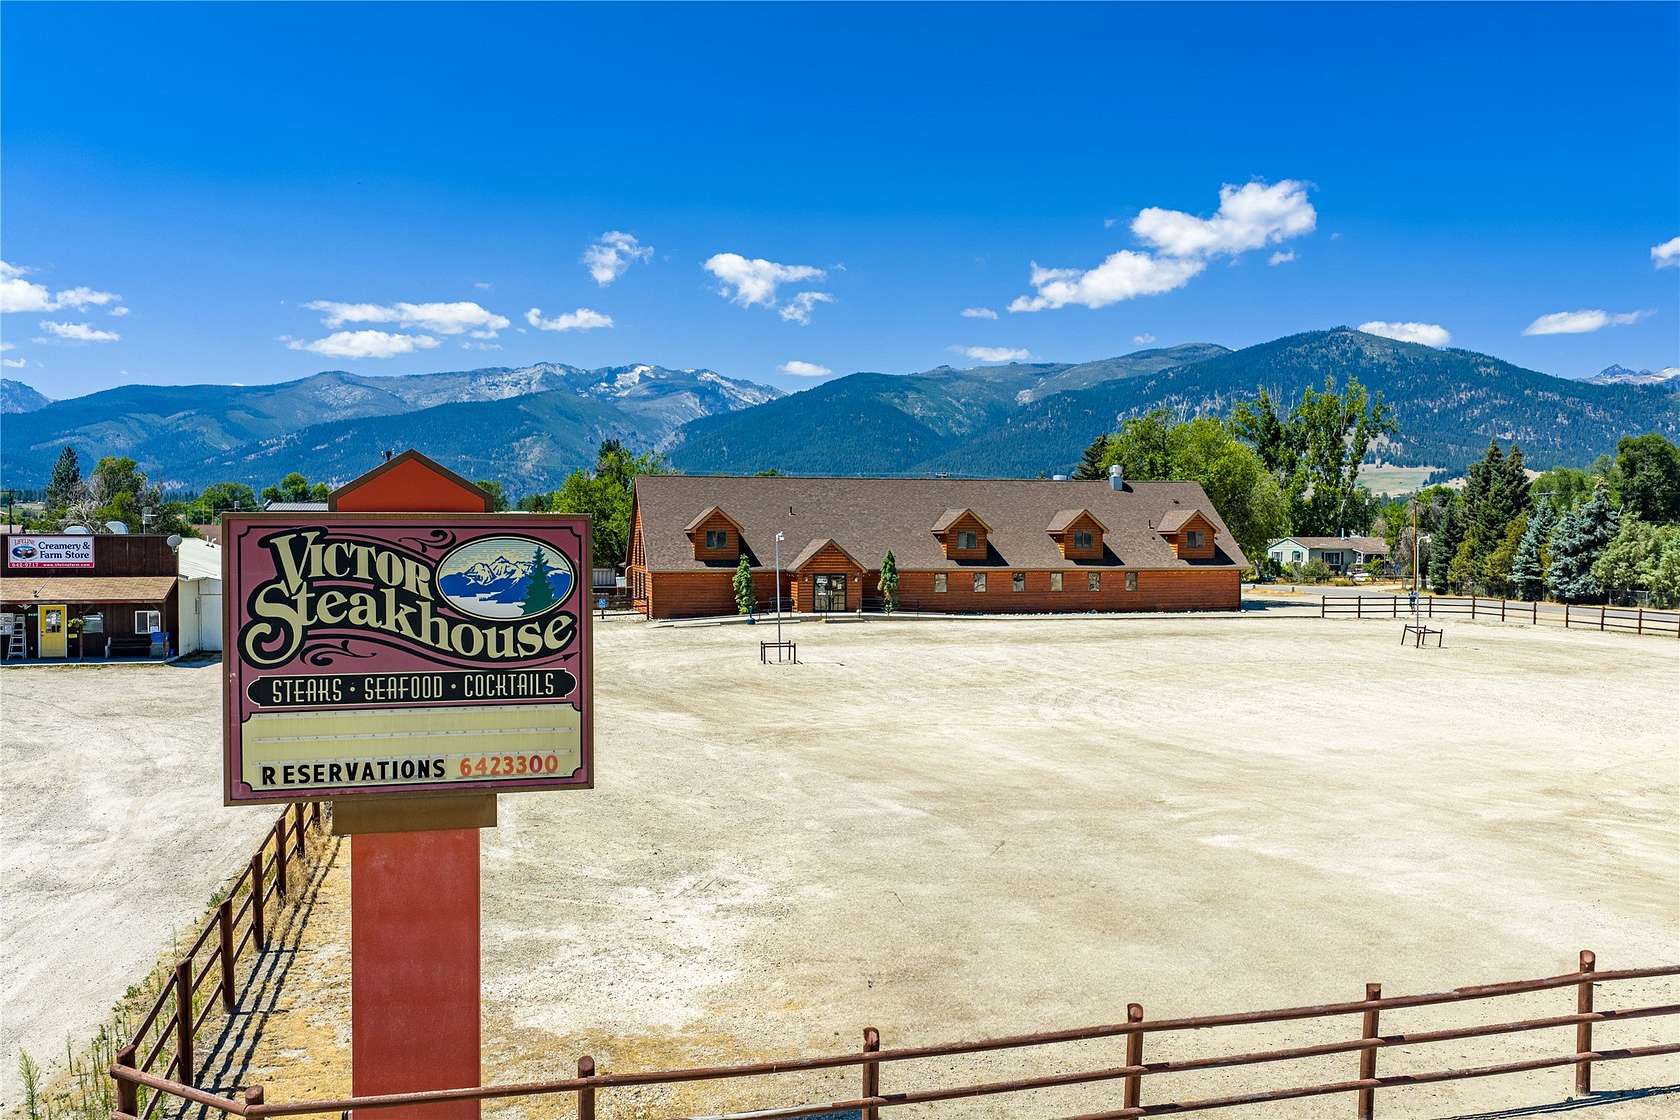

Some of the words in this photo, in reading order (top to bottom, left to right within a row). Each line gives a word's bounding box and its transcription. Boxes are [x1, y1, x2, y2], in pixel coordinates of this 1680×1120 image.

[38, 541, 81, 551] Creamery
[82, 541, 90, 550] &
[40, 551, 62, 559] Farm
[65, 550, 90, 559] Store
[245, 579, 573, 665] Steakhouse
[272, 678, 342, 703] STEAKS
[364, 675, 443, 700] SEAFOOD
[464, 672, 554, 697] COCKTAILS
[262, 758, 446, 785] RESERVATIONS
[459, 754, 560, 777] 6423300
